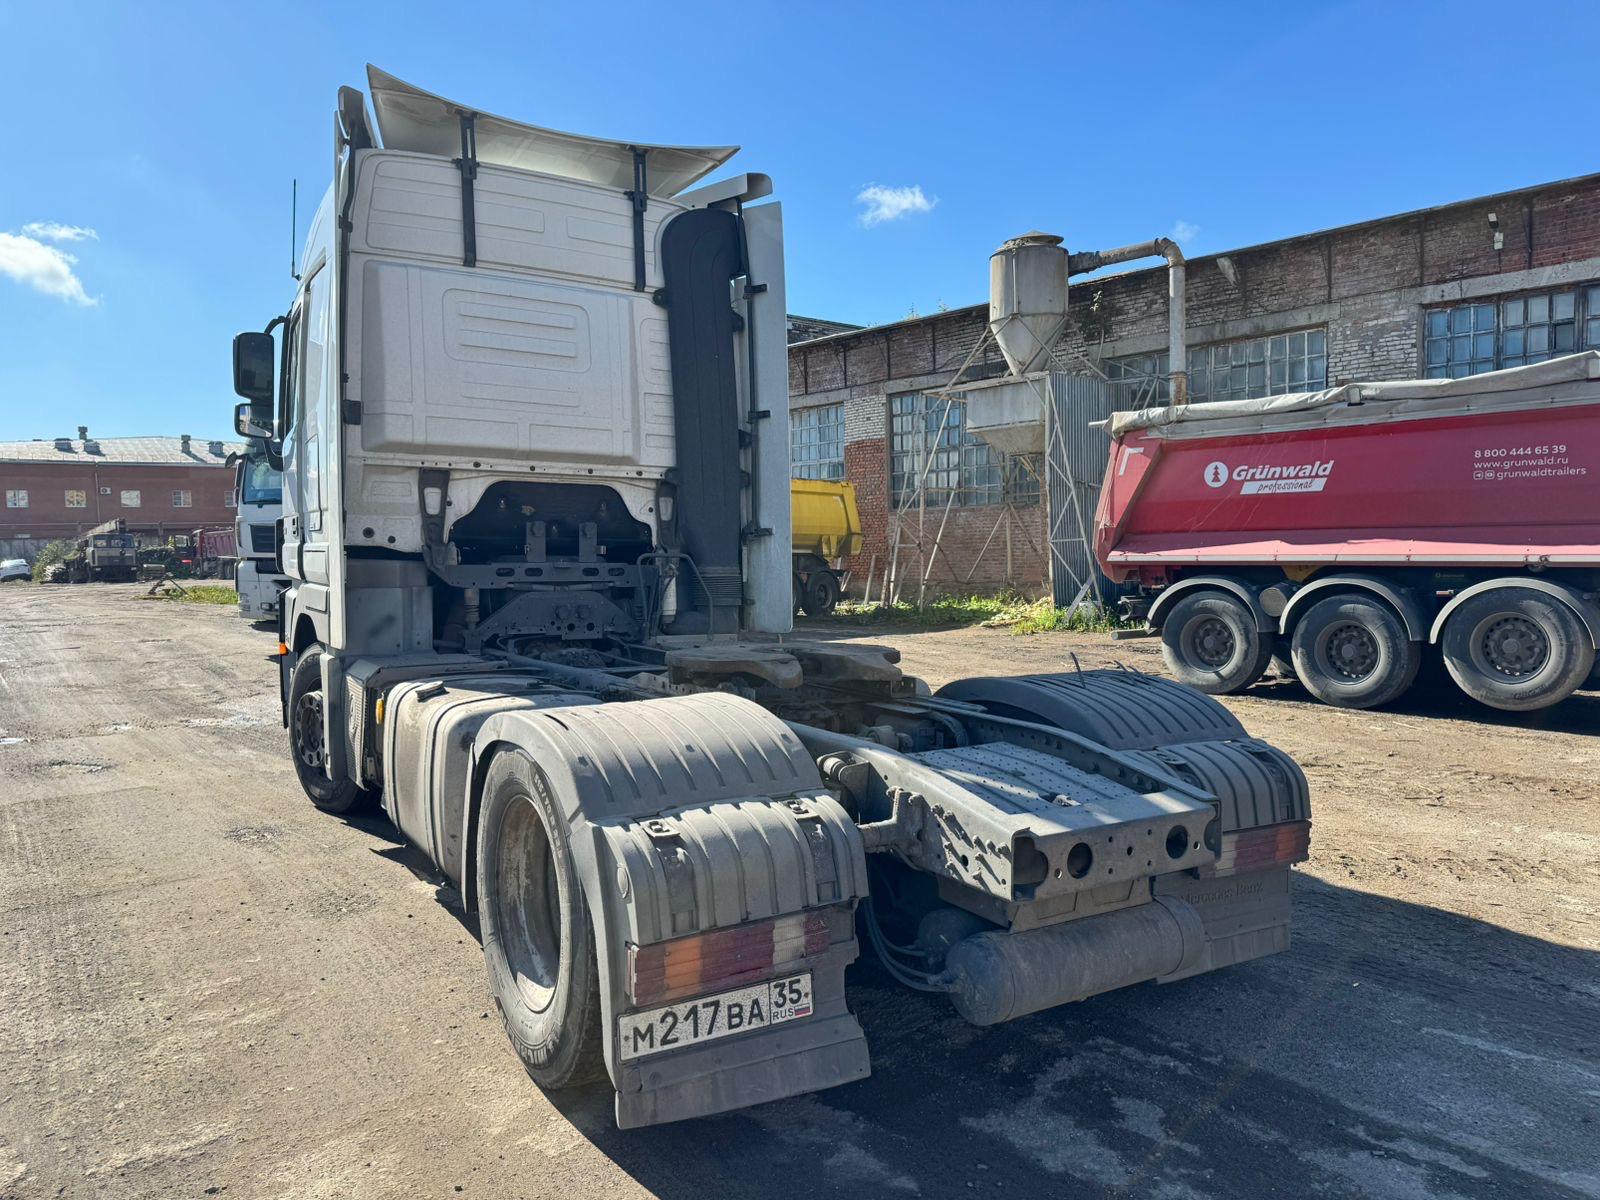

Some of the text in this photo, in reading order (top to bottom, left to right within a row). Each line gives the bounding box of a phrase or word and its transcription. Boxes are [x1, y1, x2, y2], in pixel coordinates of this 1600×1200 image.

[1474, 444, 1567, 458] 8 800 444 65 39
[1232, 460, 1335, 480] Grünwald
[1474, 456, 1569, 469] www.grunwald.ru
[1497, 467, 1587, 480] grunwaldtrailers
[1257, 479, 1313, 494] professional
[772, 978, 802, 1009] 35
[772, 1006, 794, 1021] RUS
